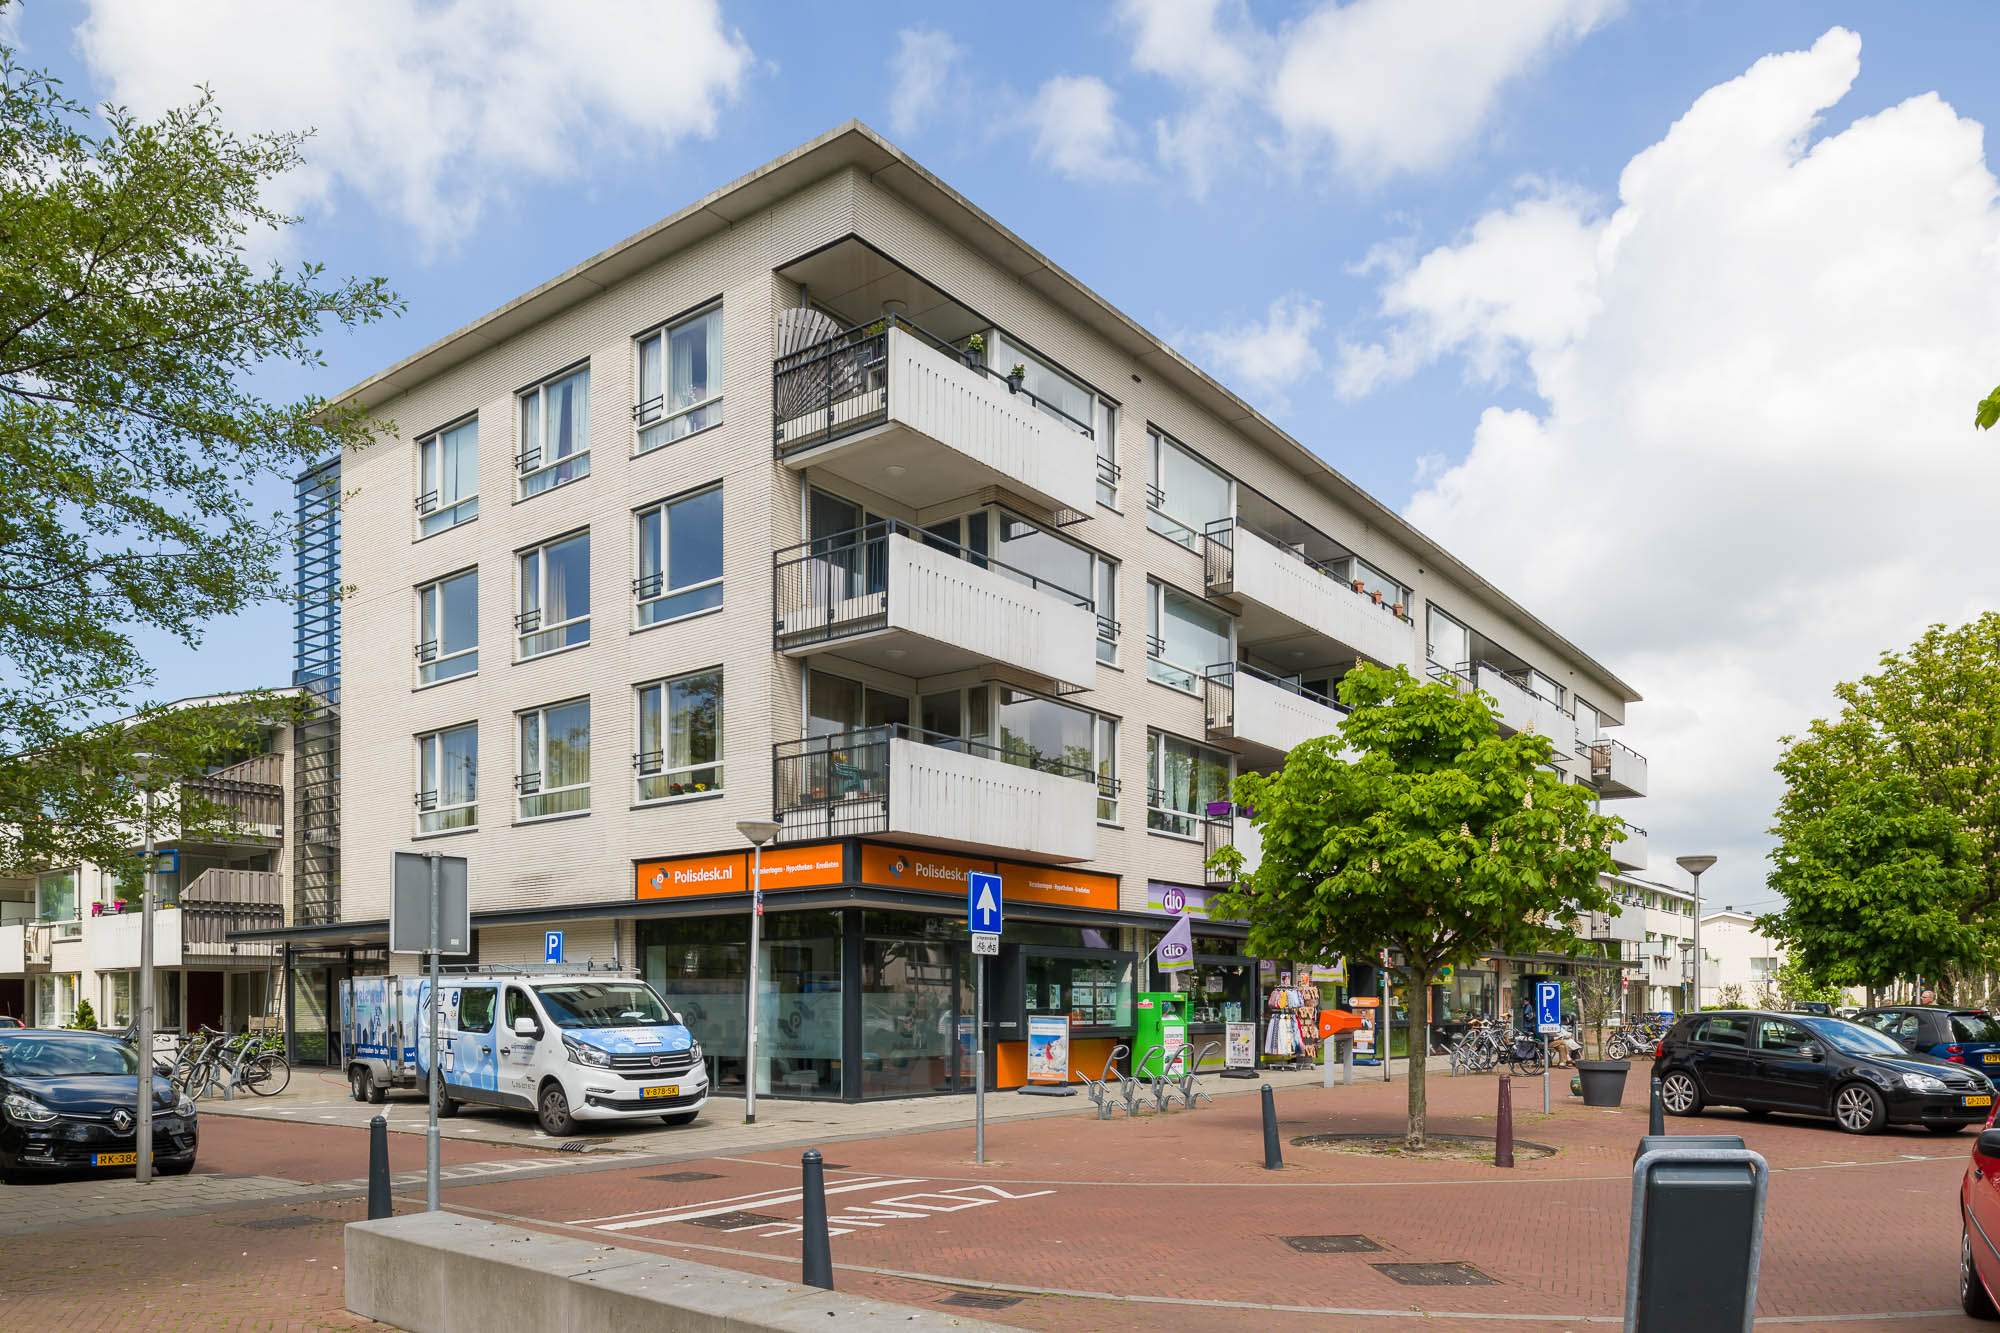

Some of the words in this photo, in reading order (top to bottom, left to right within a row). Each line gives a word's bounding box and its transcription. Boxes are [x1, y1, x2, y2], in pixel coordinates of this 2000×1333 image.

[674, 865, 733, 884] Polisdesk.nl
[915, 863, 970, 882] Polisdesk.n
[1164, 888, 1183, 910] dio
[548, 935, 559, 955] P
[1163, 944, 1184, 957] dio
[1542, 986, 1556, 1008] P
[645, 1086, 677, 1097] V-878-SK
[722, 1185, 1057, 1241] ZONE
